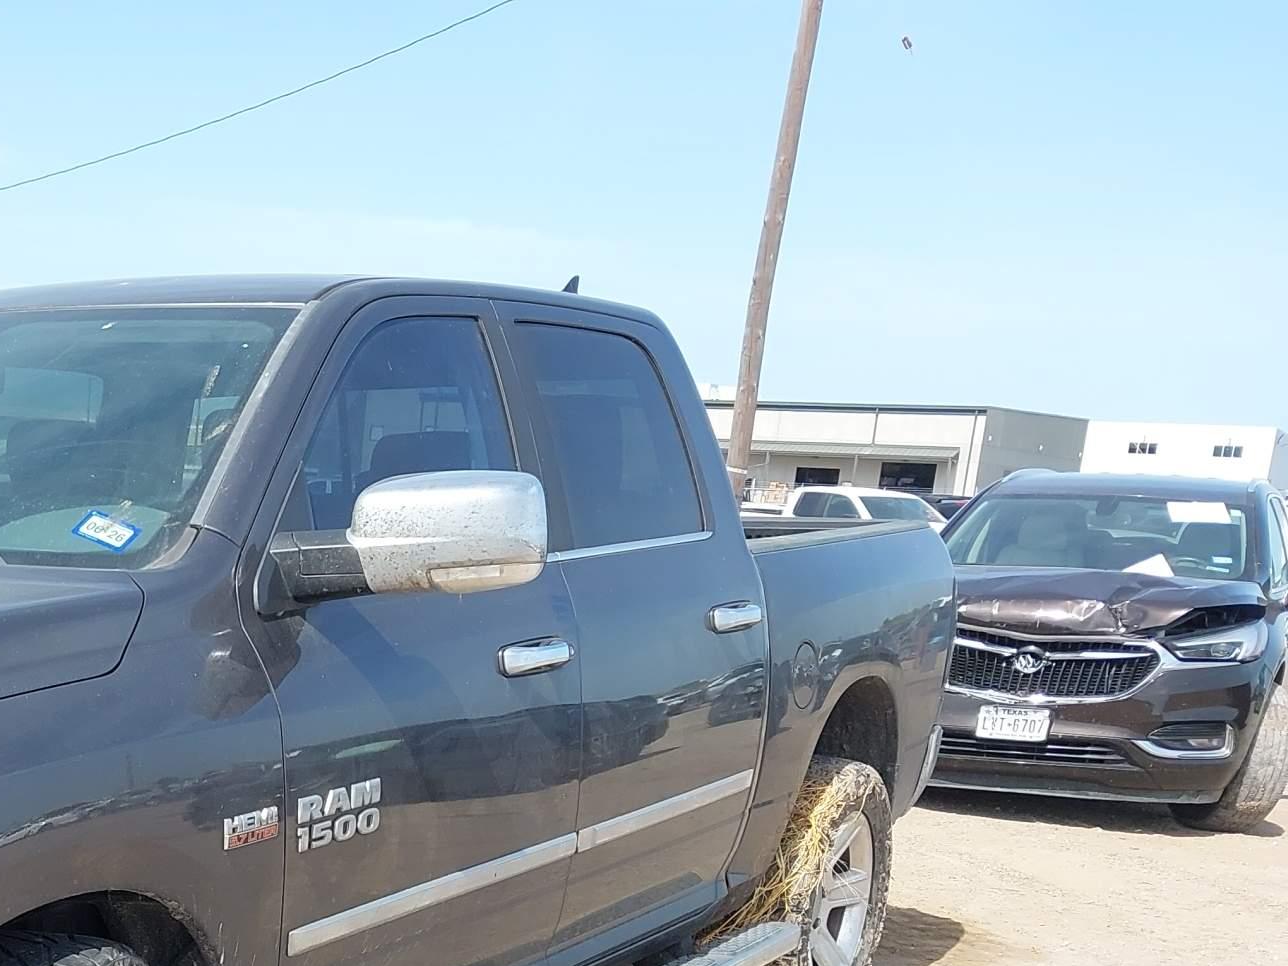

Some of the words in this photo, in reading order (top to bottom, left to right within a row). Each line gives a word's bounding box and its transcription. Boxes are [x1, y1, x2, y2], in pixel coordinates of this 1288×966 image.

[1000, 708, 1029, 716] TEXAS
[223, 805, 279, 835] HEMI
[297, 777, 381, 825] RAM
[296, 807, 381, 854] 1500
